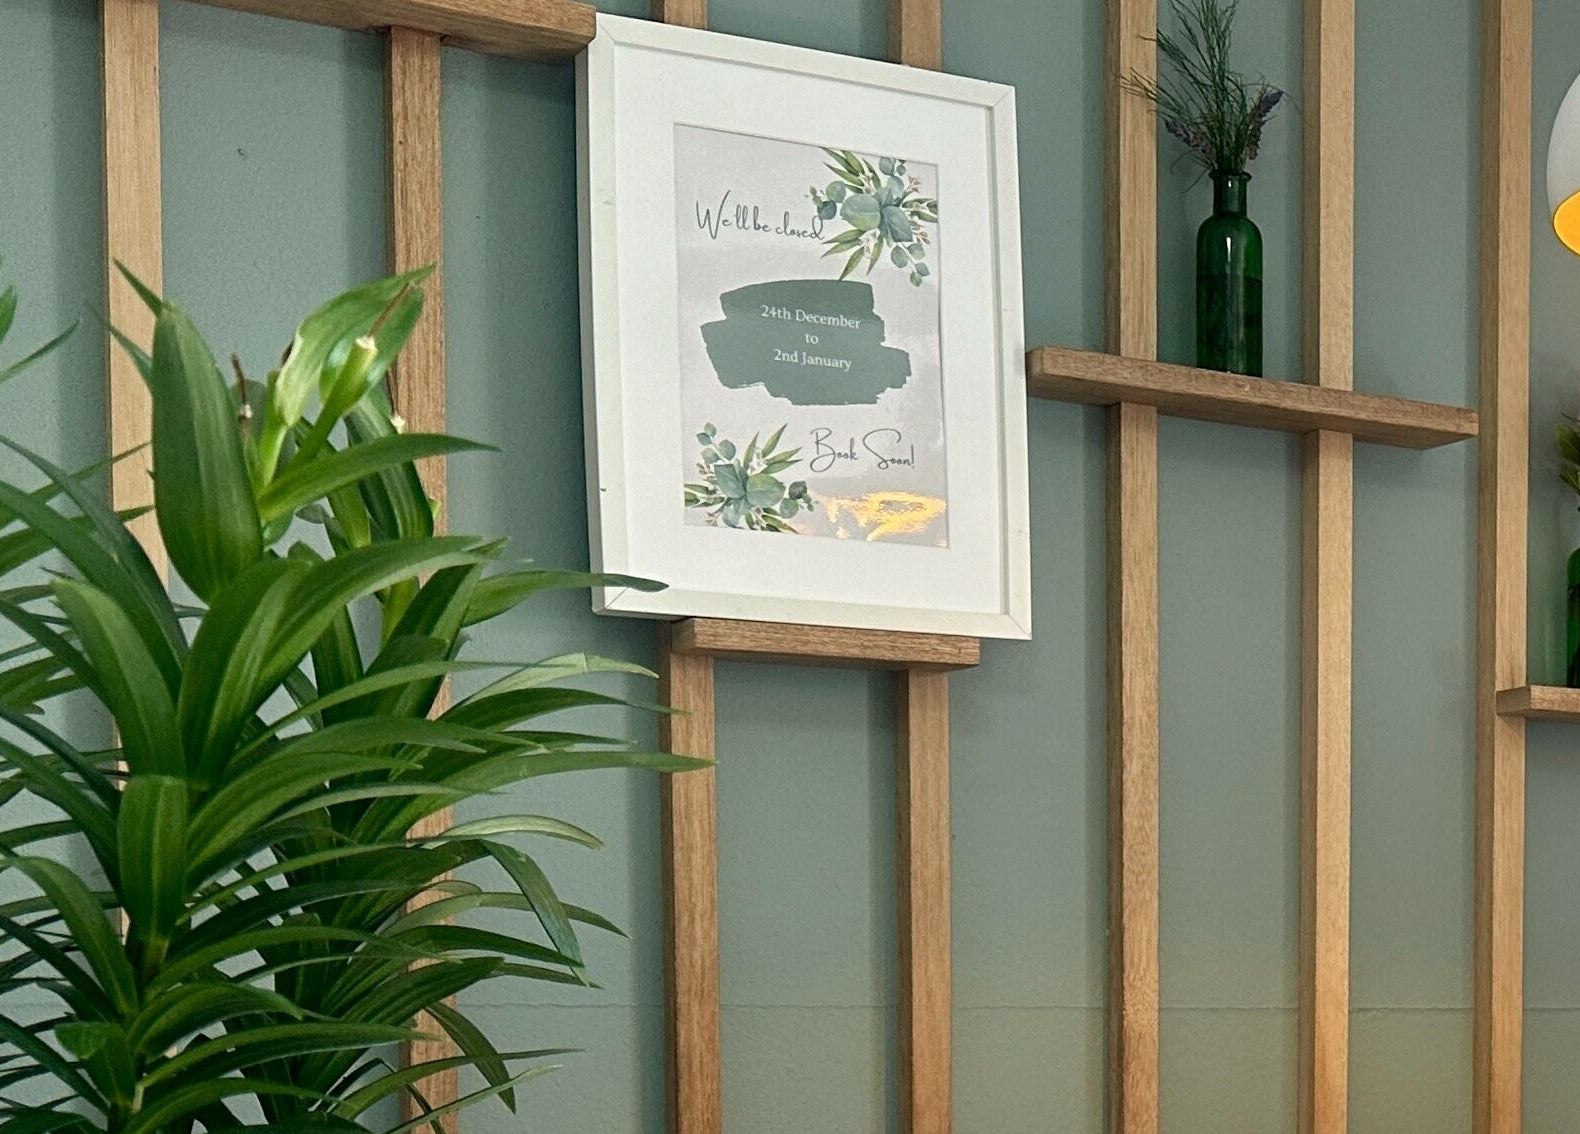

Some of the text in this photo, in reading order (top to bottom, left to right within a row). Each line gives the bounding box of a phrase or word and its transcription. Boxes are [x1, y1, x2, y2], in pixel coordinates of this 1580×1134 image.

[753, 211, 771, 233] be
[776, 211, 825, 240] closed
[760, 304, 861, 330] 24th December
[805, 332, 819, 345] to
[773, 349, 852, 372] 2nd January
[809, 427, 915, 473] Book Soon!
